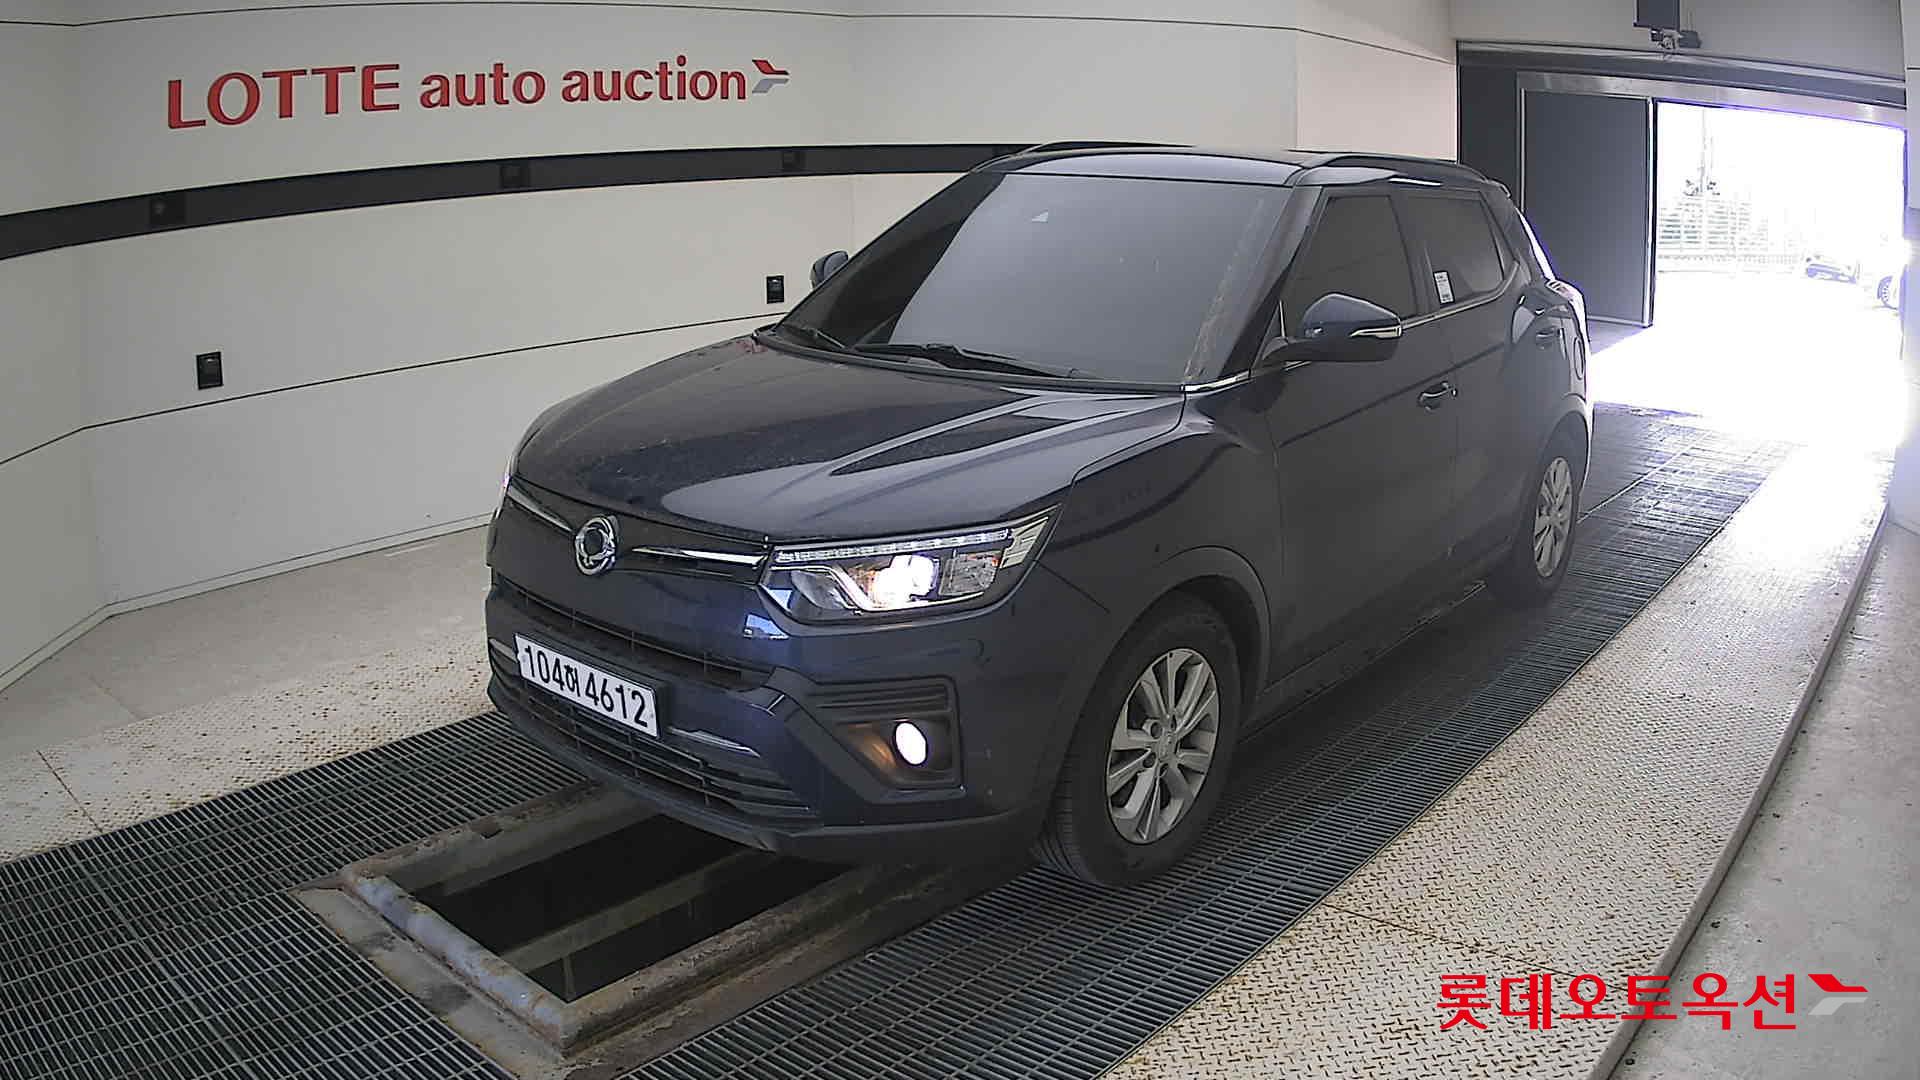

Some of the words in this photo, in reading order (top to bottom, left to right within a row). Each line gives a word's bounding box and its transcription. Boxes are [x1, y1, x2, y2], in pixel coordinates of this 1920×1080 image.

[167, 63, 401, 130] LOTTE
[419, 62, 546, 109] auto
[560, 54, 748, 102] auction
[585, 671, 649, 728] 4612
